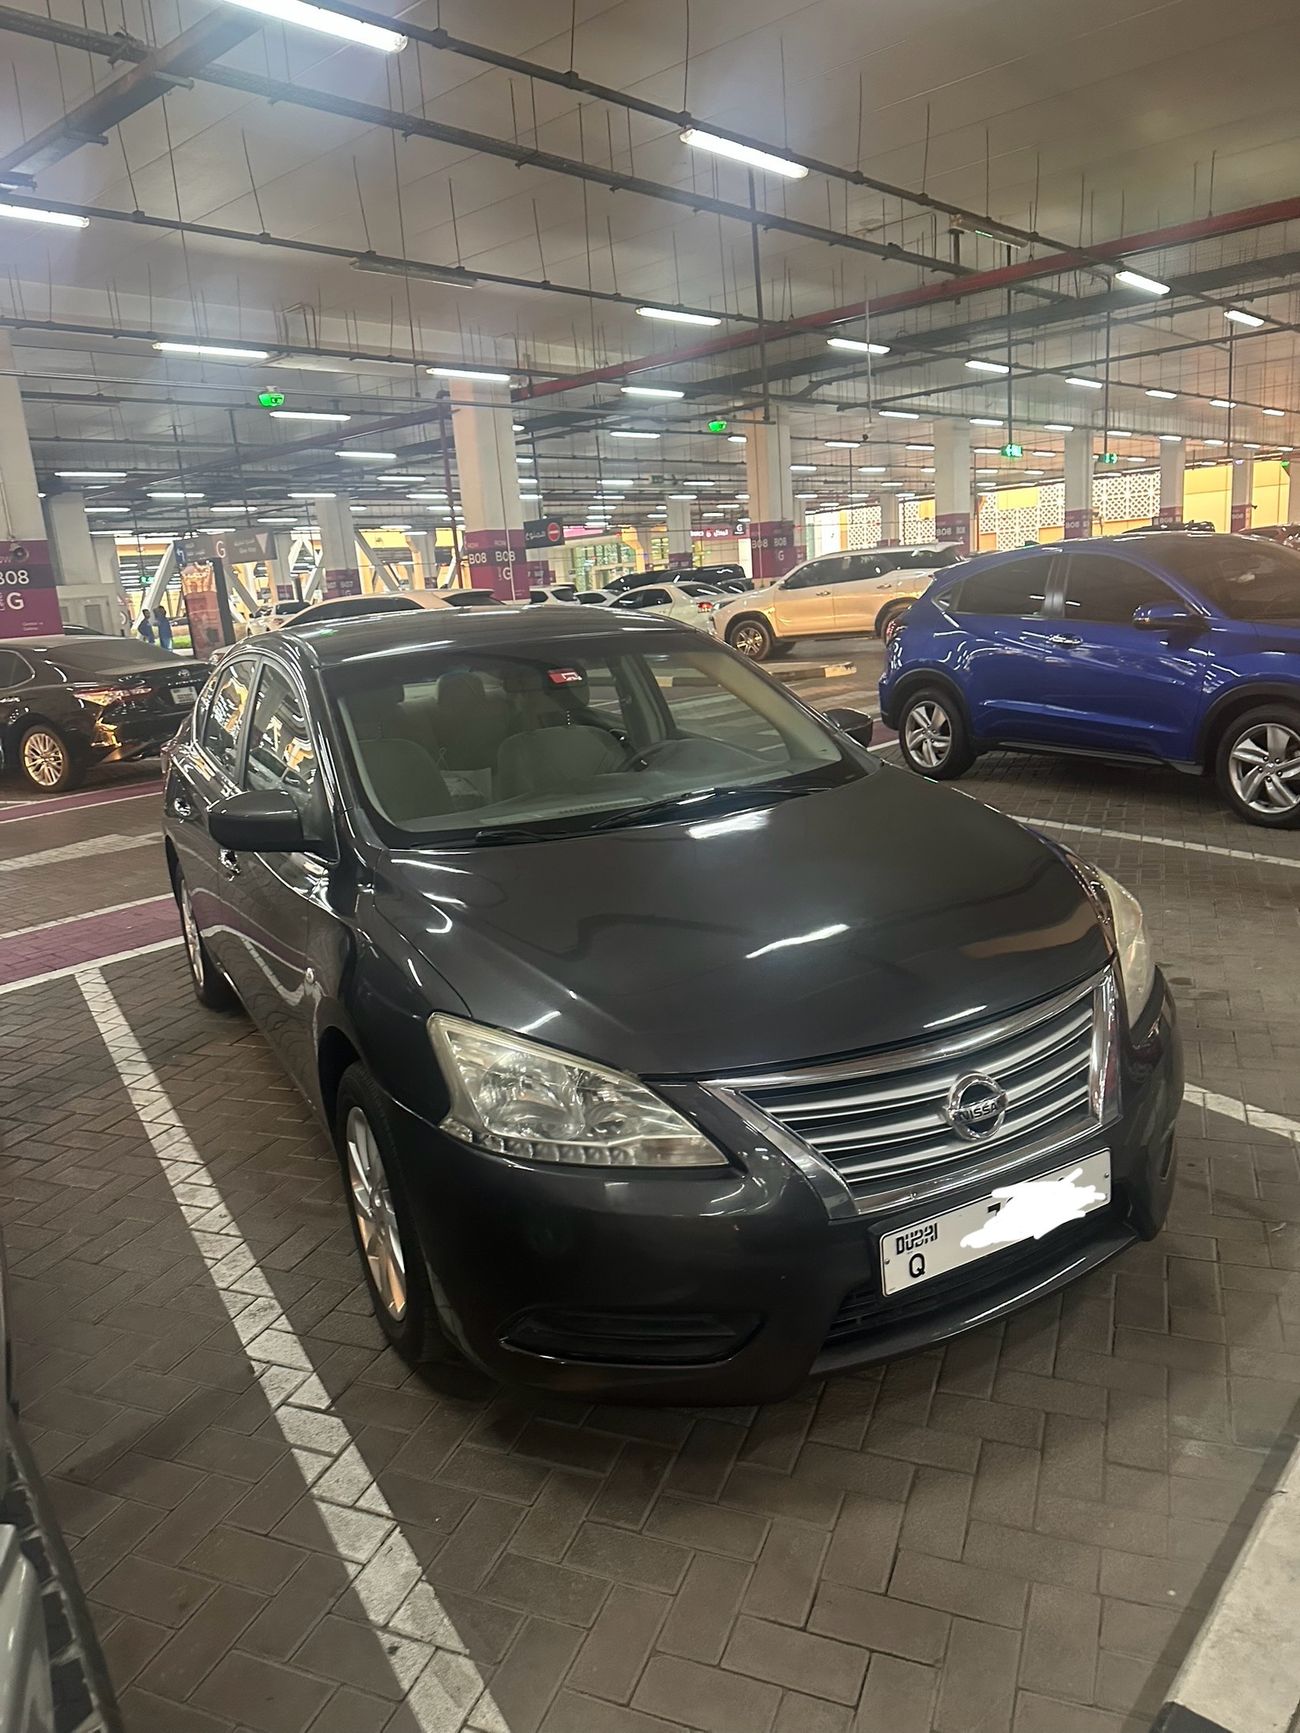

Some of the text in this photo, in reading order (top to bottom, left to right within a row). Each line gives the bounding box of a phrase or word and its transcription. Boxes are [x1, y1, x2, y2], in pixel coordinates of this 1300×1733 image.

[216, 540, 226, 558] G
[495, 551, 516, 562] B08
[778, 550, 785, 561] G
[468, 553, 488, 565] B08
[6, 592, 25, 610] G
[895, 1222, 938, 1256] DUBAI
[908, 1252, 926, 1279] Q
